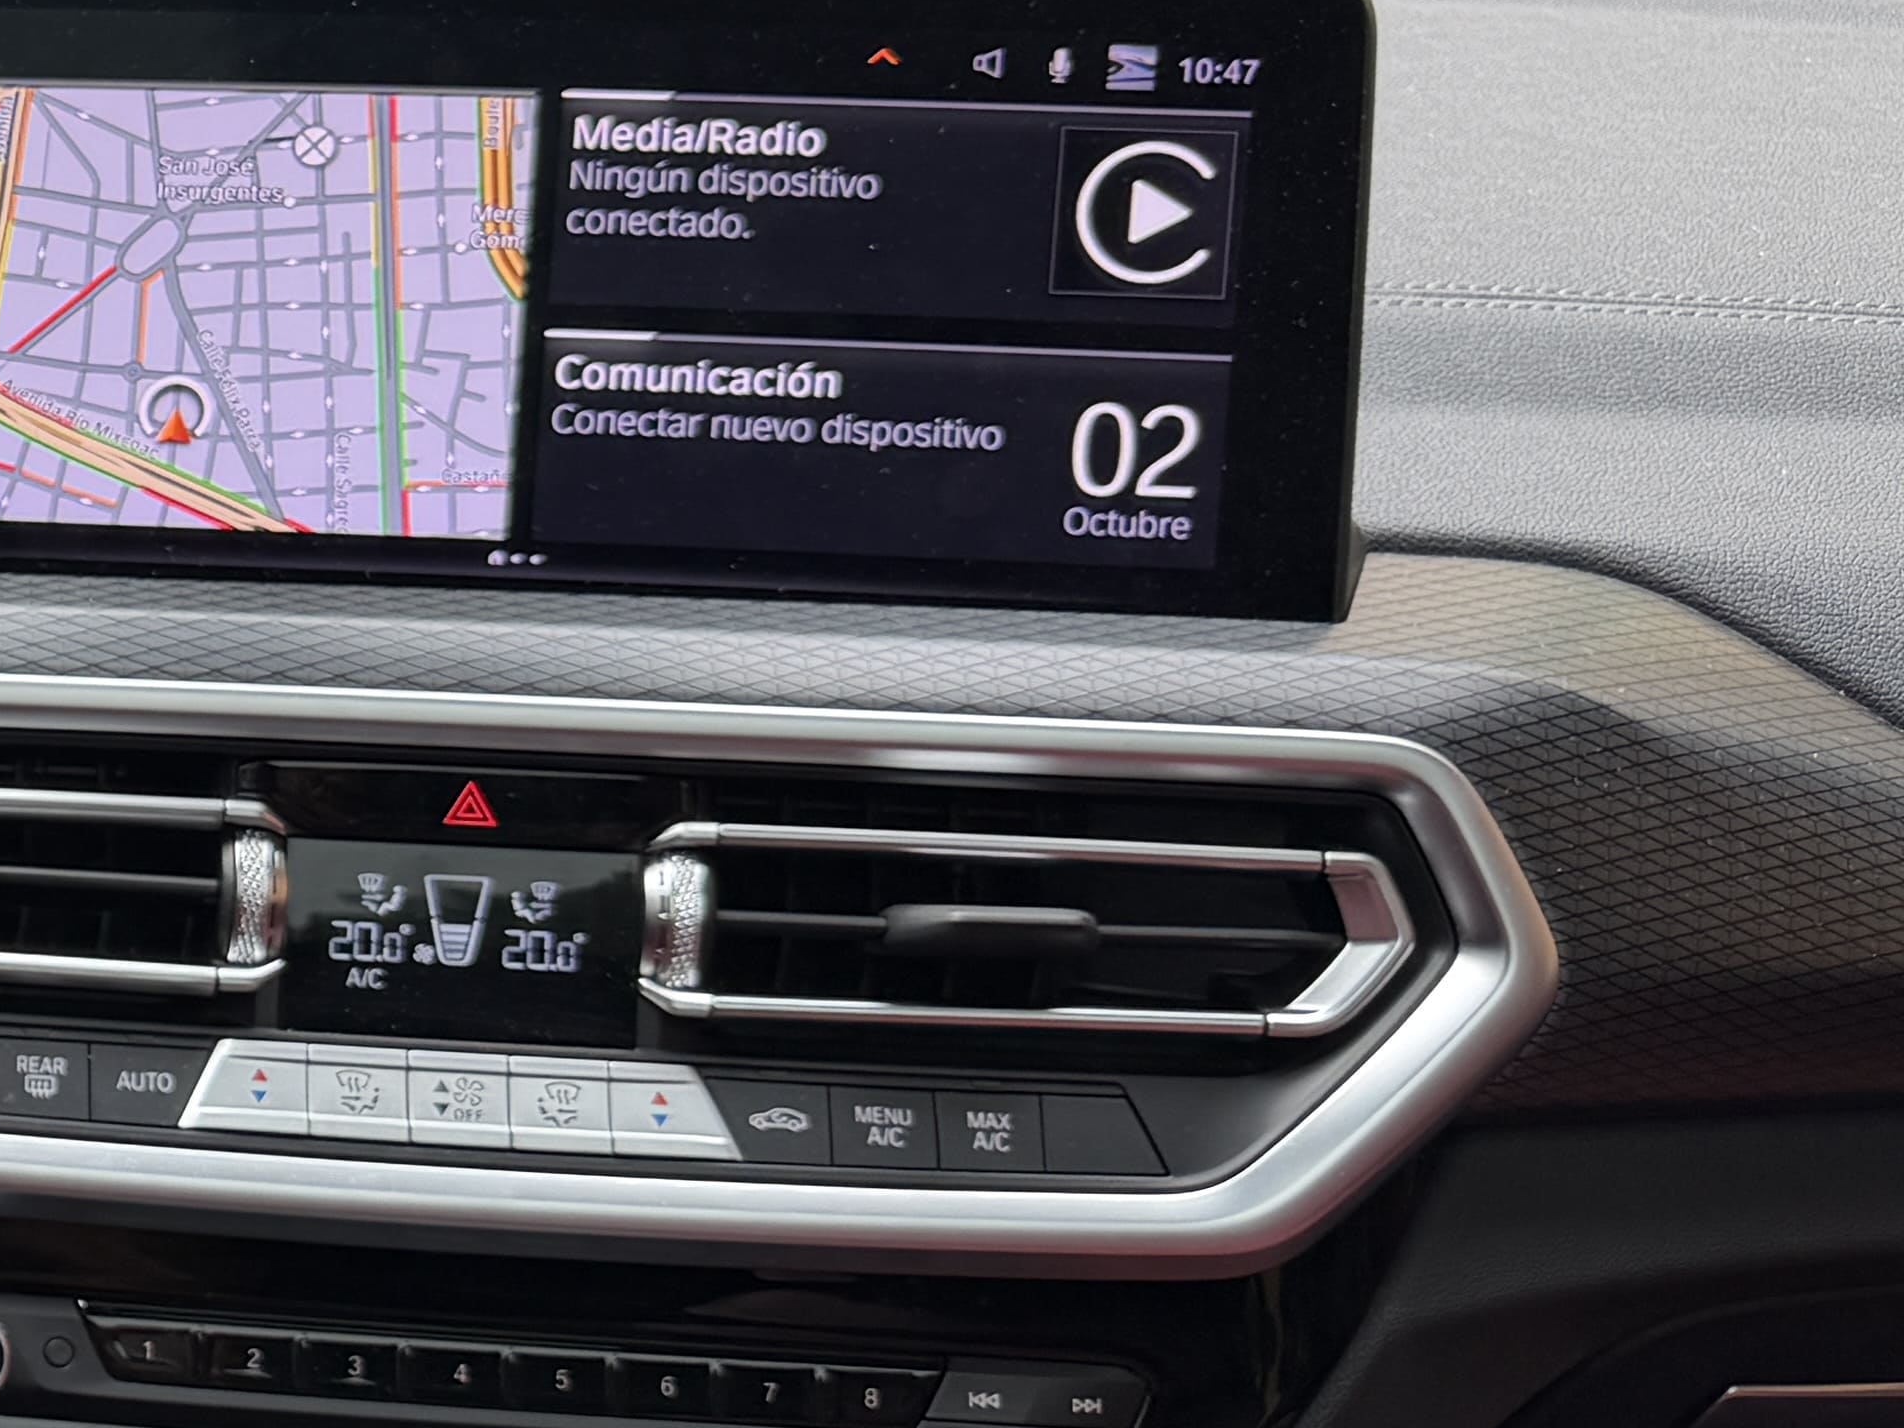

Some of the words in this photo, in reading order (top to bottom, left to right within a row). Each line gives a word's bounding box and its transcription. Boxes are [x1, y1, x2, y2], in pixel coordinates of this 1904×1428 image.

[1178, 55, 1260, 86] 10:47
[572, 115, 828, 157] Media/Radio
[158, 155, 199, 176] San
[202, 156, 256, 178] José
[569, 158, 692, 199] Ningún
[697, 162, 882, 203] dispositivo
[156, 180, 286, 205] Insurgentes
[565, 207, 757, 240] conectado.
[196, 329, 224, 366] Calle
[555, 355, 844, 399] Comunicación
[0, 377, 64, 420] Avenida
[550, 403, 705, 439] Conectar
[709, 414, 815, 444] nuevo
[821, 413, 1006, 452] dispositivo
[1071, 401, 1202, 500] 02
[1063, 505, 1193, 541] Octubre
[345, 967, 389, 990] A/C
[16, 1055, 68, 1075] REAR
[116, 1071, 176, 1093] AUTO
[454, 1108, 483, 1122] OFF
[854, 1105, 912, 1126] MENU
[966, 1111, 1011, 1130] MAX
[866, 1126, 905, 1148] A/C
[972, 1131, 1010, 1152] A/C
[142, 1340, 156, 1361] 1
[246, 1348, 263, 1370] 2
[347, 1356, 366, 1377] 3
[453, 1363, 471, 1383] 4
[554, 1369, 573, 1391] 5
[659, 1376, 678, 1397] 6
[762, 1381, 779, 1402] 7
[863, 1387, 881, 1409] 8
